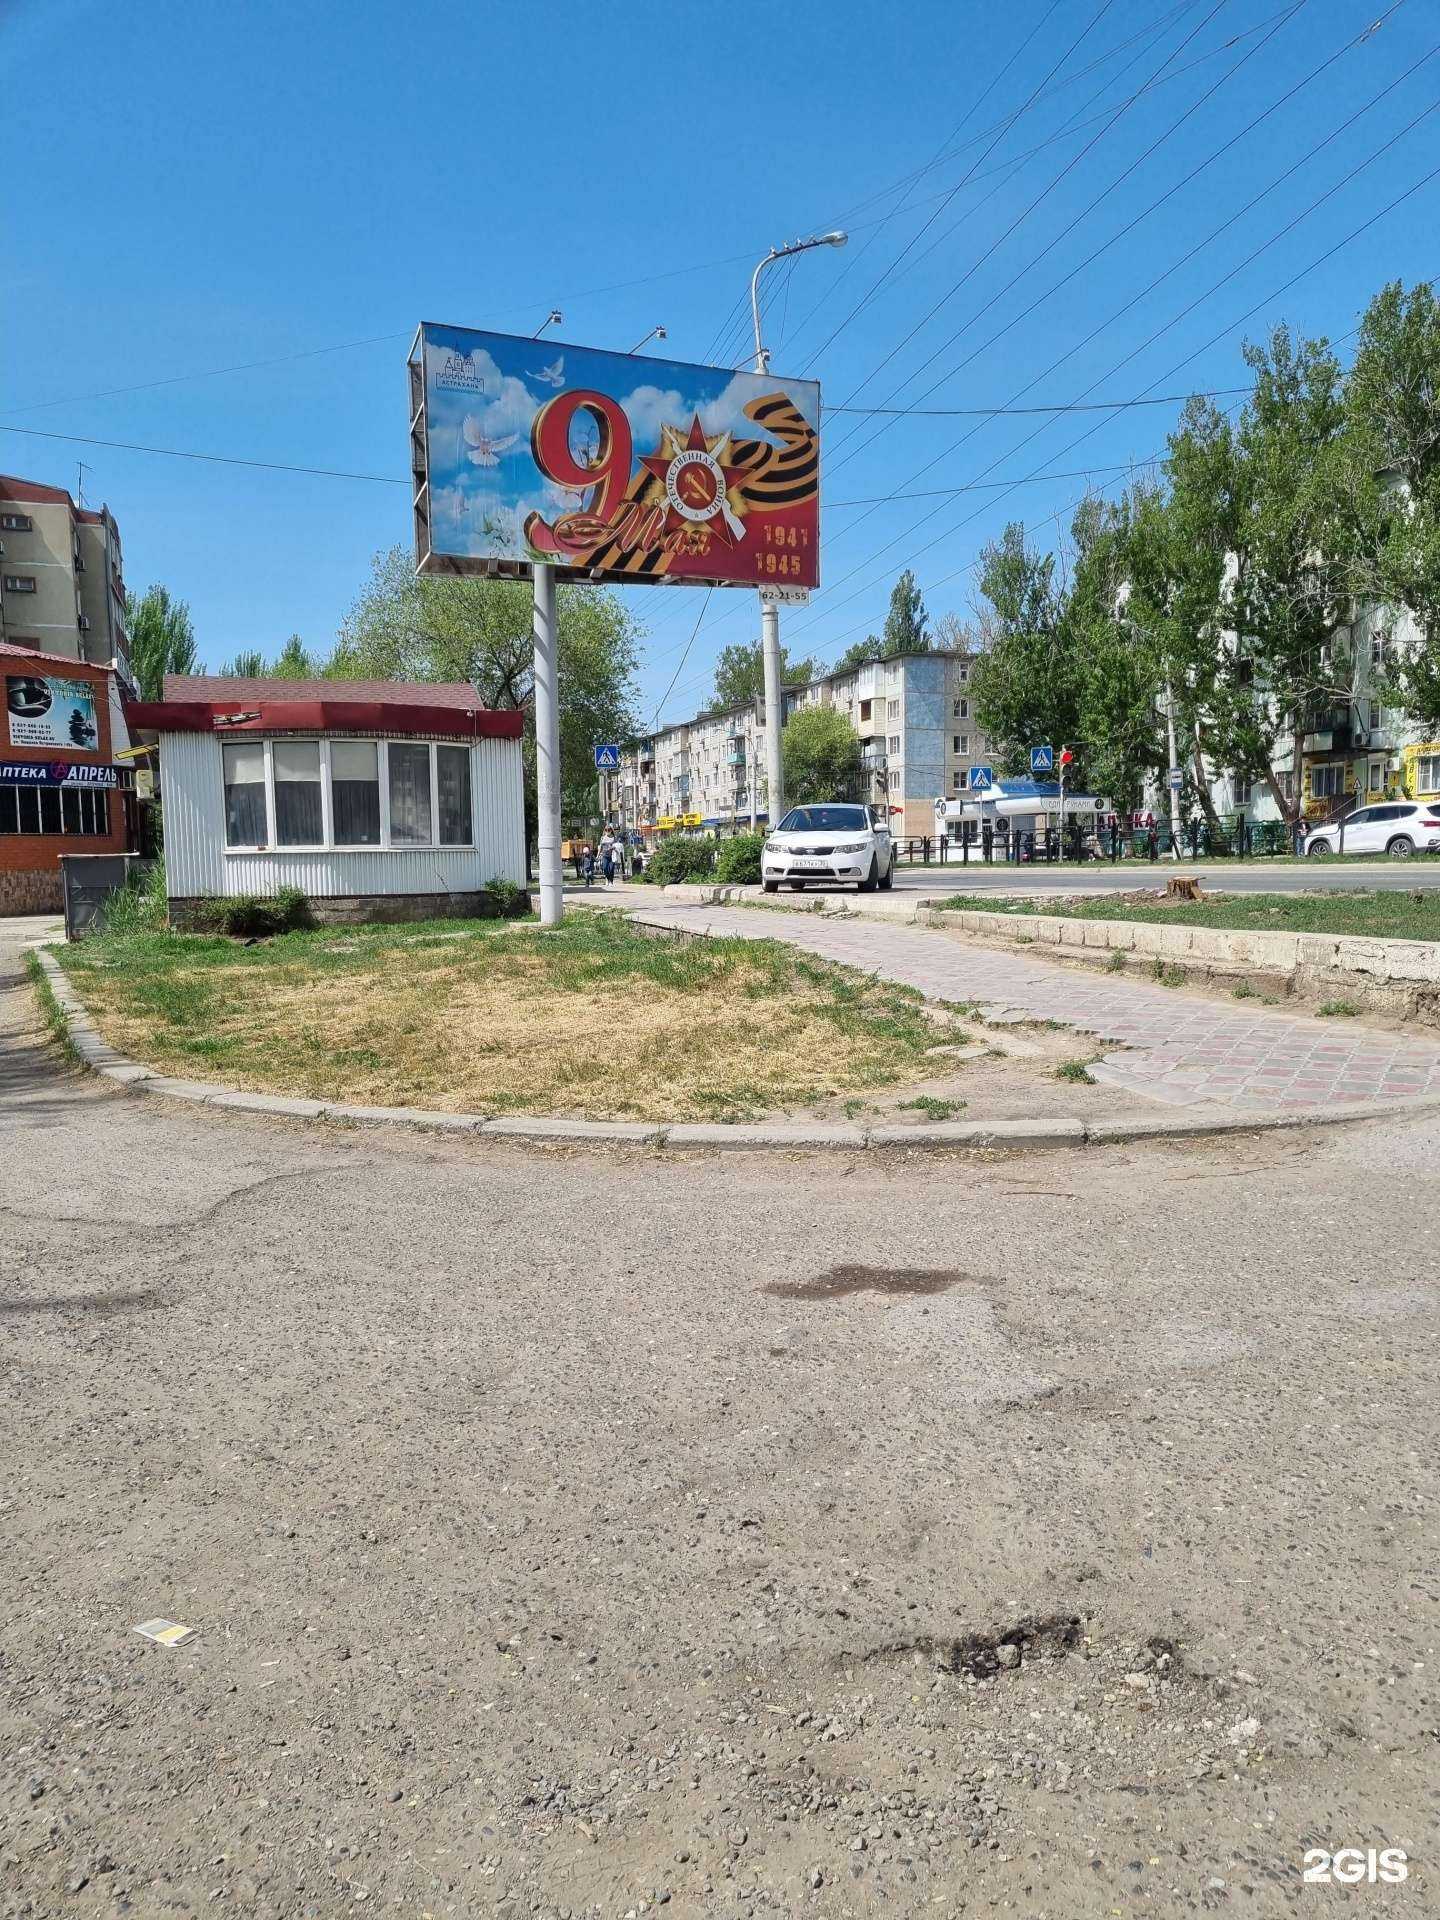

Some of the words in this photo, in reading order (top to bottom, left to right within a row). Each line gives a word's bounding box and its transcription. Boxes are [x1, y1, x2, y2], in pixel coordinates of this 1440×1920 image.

[440, 379, 479, 389] АСТРАХАНЬ
[526, 388, 633, 553] 9
[667, 452, 716, 511] ОТЕЧЕСТВЕННАЯ
[763, 524, 808, 548] 1941
[755, 552, 801, 576] 1945
[761, 590, 808, 601] 62-21-55
[67, 765, 117, 782] АПРЕЛЬ
